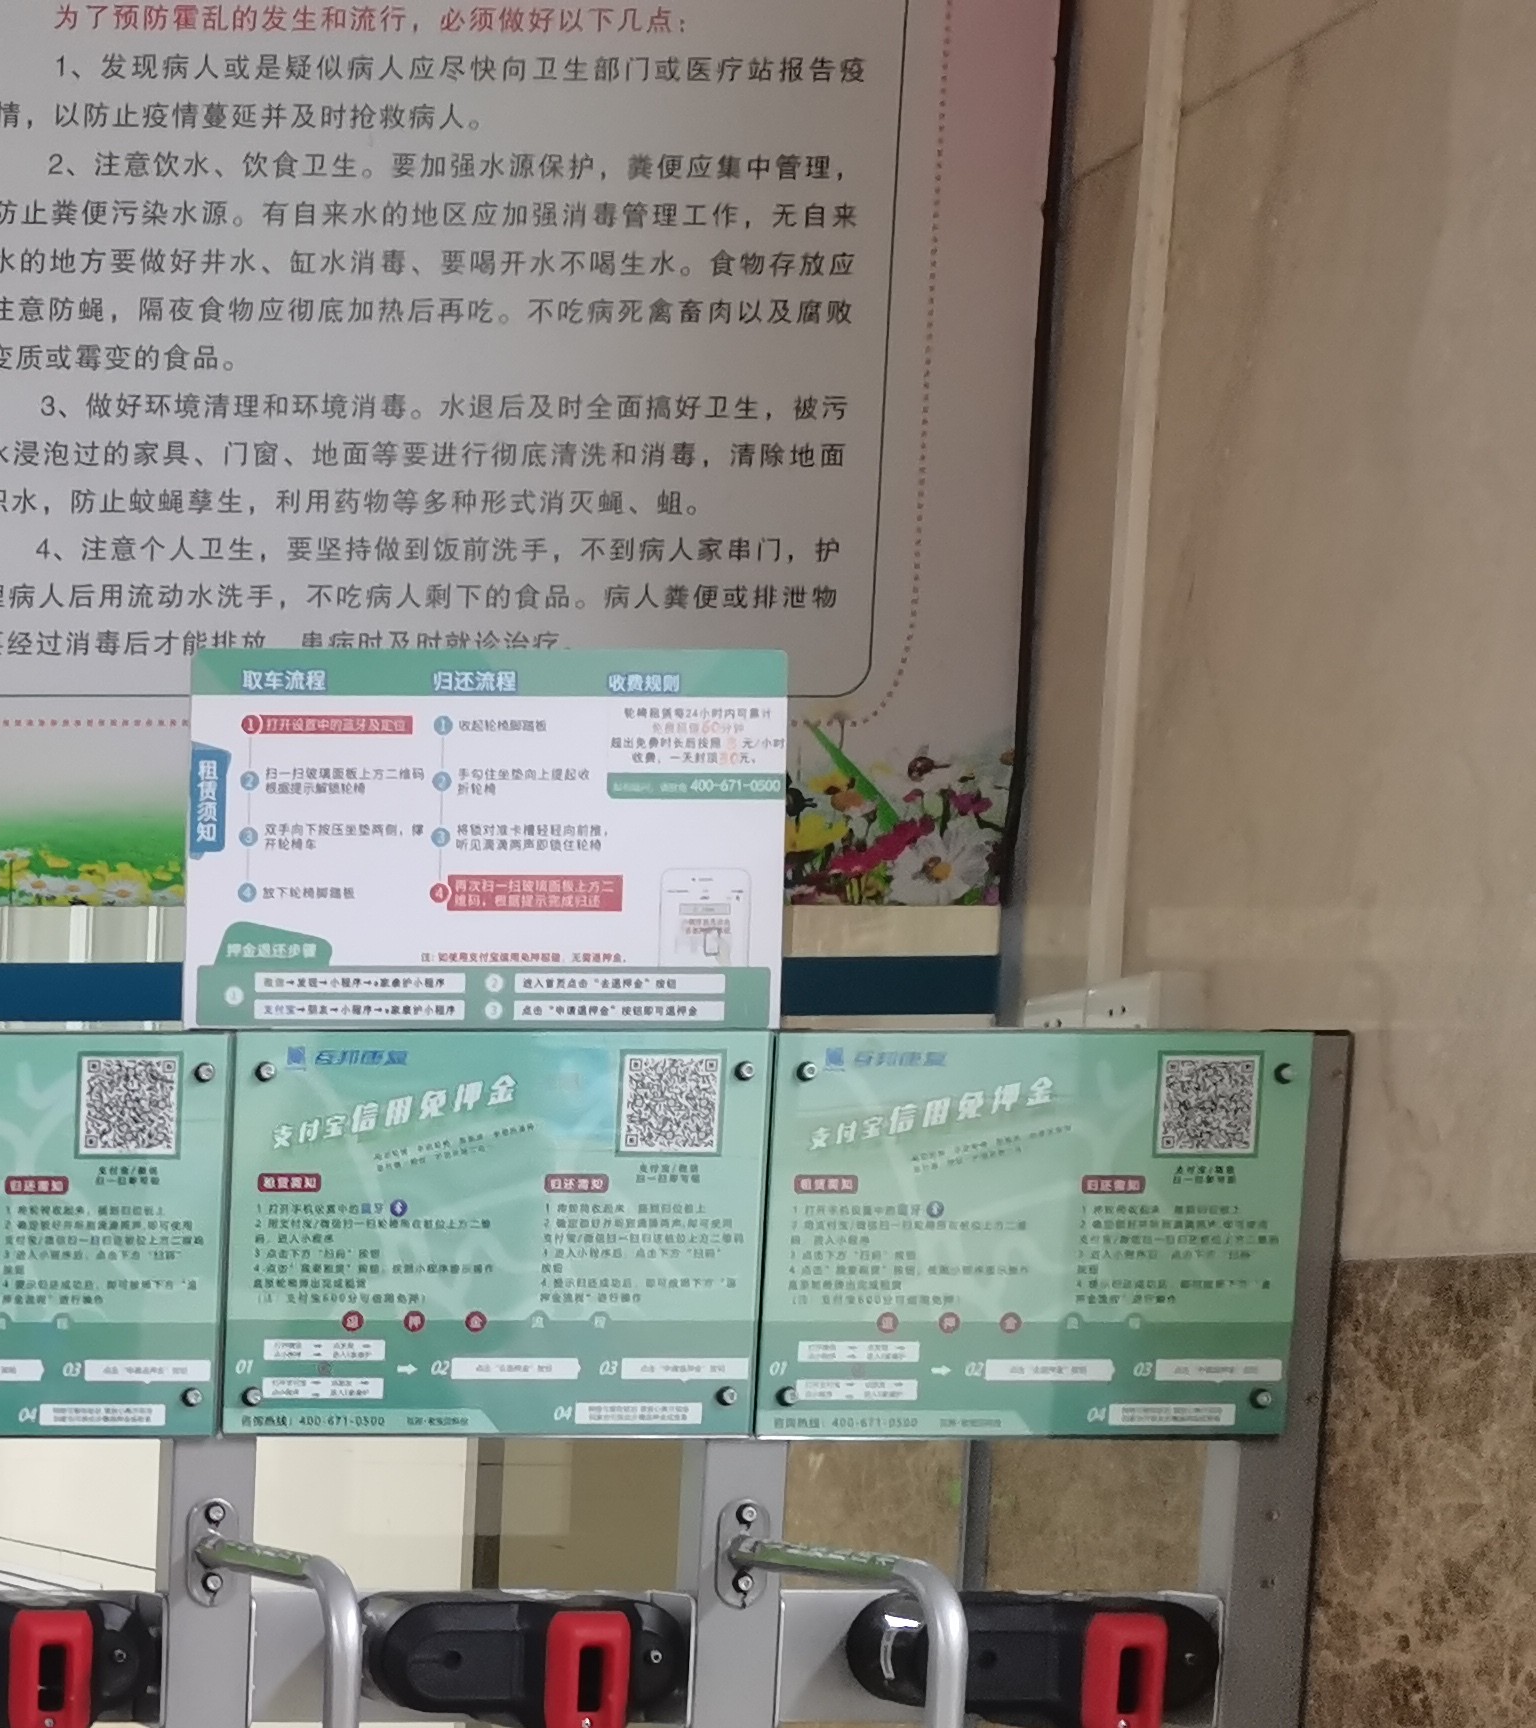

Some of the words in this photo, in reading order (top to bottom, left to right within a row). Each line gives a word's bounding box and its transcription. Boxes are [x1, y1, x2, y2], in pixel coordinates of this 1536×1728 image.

[242, 669, 327, 691] 取车流程
[433, 671, 517, 692] 归还流程
[609, 673, 680, 692] 收费规则
[690, 779, 781, 793] 400-671-0500
[271, 1074, 517, 1150] 支付宝信用免押金
[807, 1077, 1055, 1150] 支付宝信用免押金
